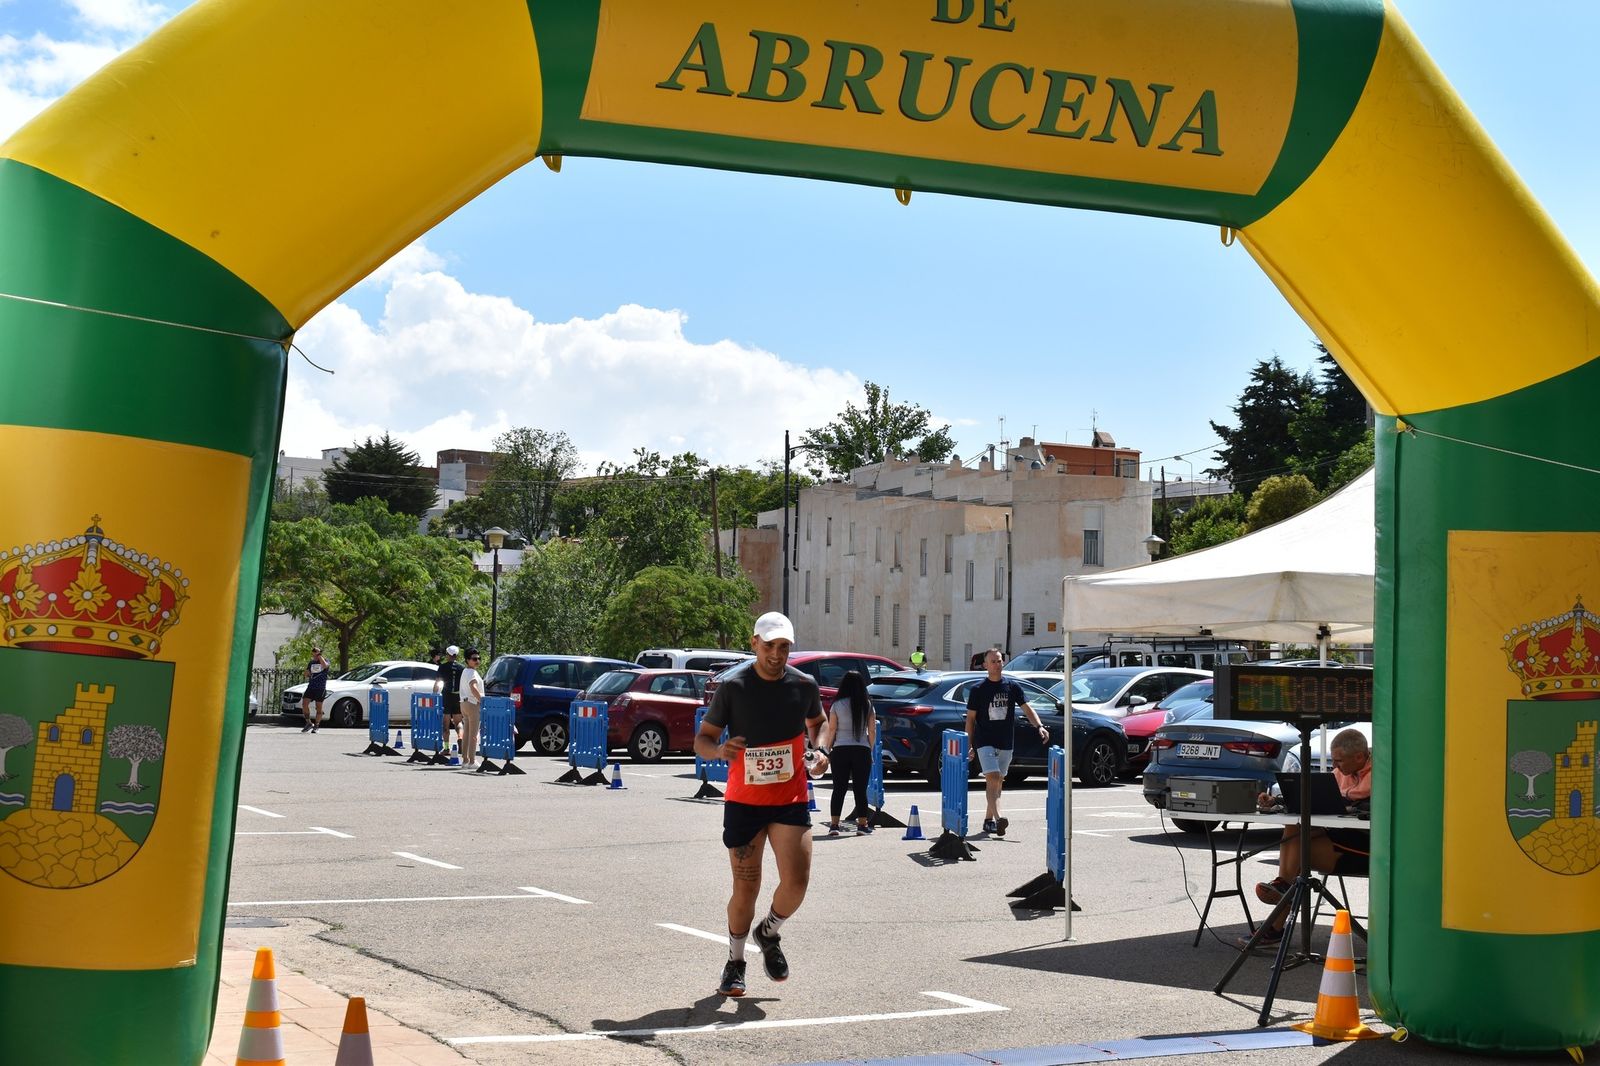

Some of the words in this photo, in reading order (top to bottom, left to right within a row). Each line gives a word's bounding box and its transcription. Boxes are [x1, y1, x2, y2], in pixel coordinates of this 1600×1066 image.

[931, 0, 1016, 32] DE
[655, 22, 1224, 156] ABRUCENA
[745, 749, 790, 757] MILENARIA
[1181, 745, 1200, 755] 9268
[1202, 746, 1219, 756] JNT
[756, 757, 784, 771] 533
